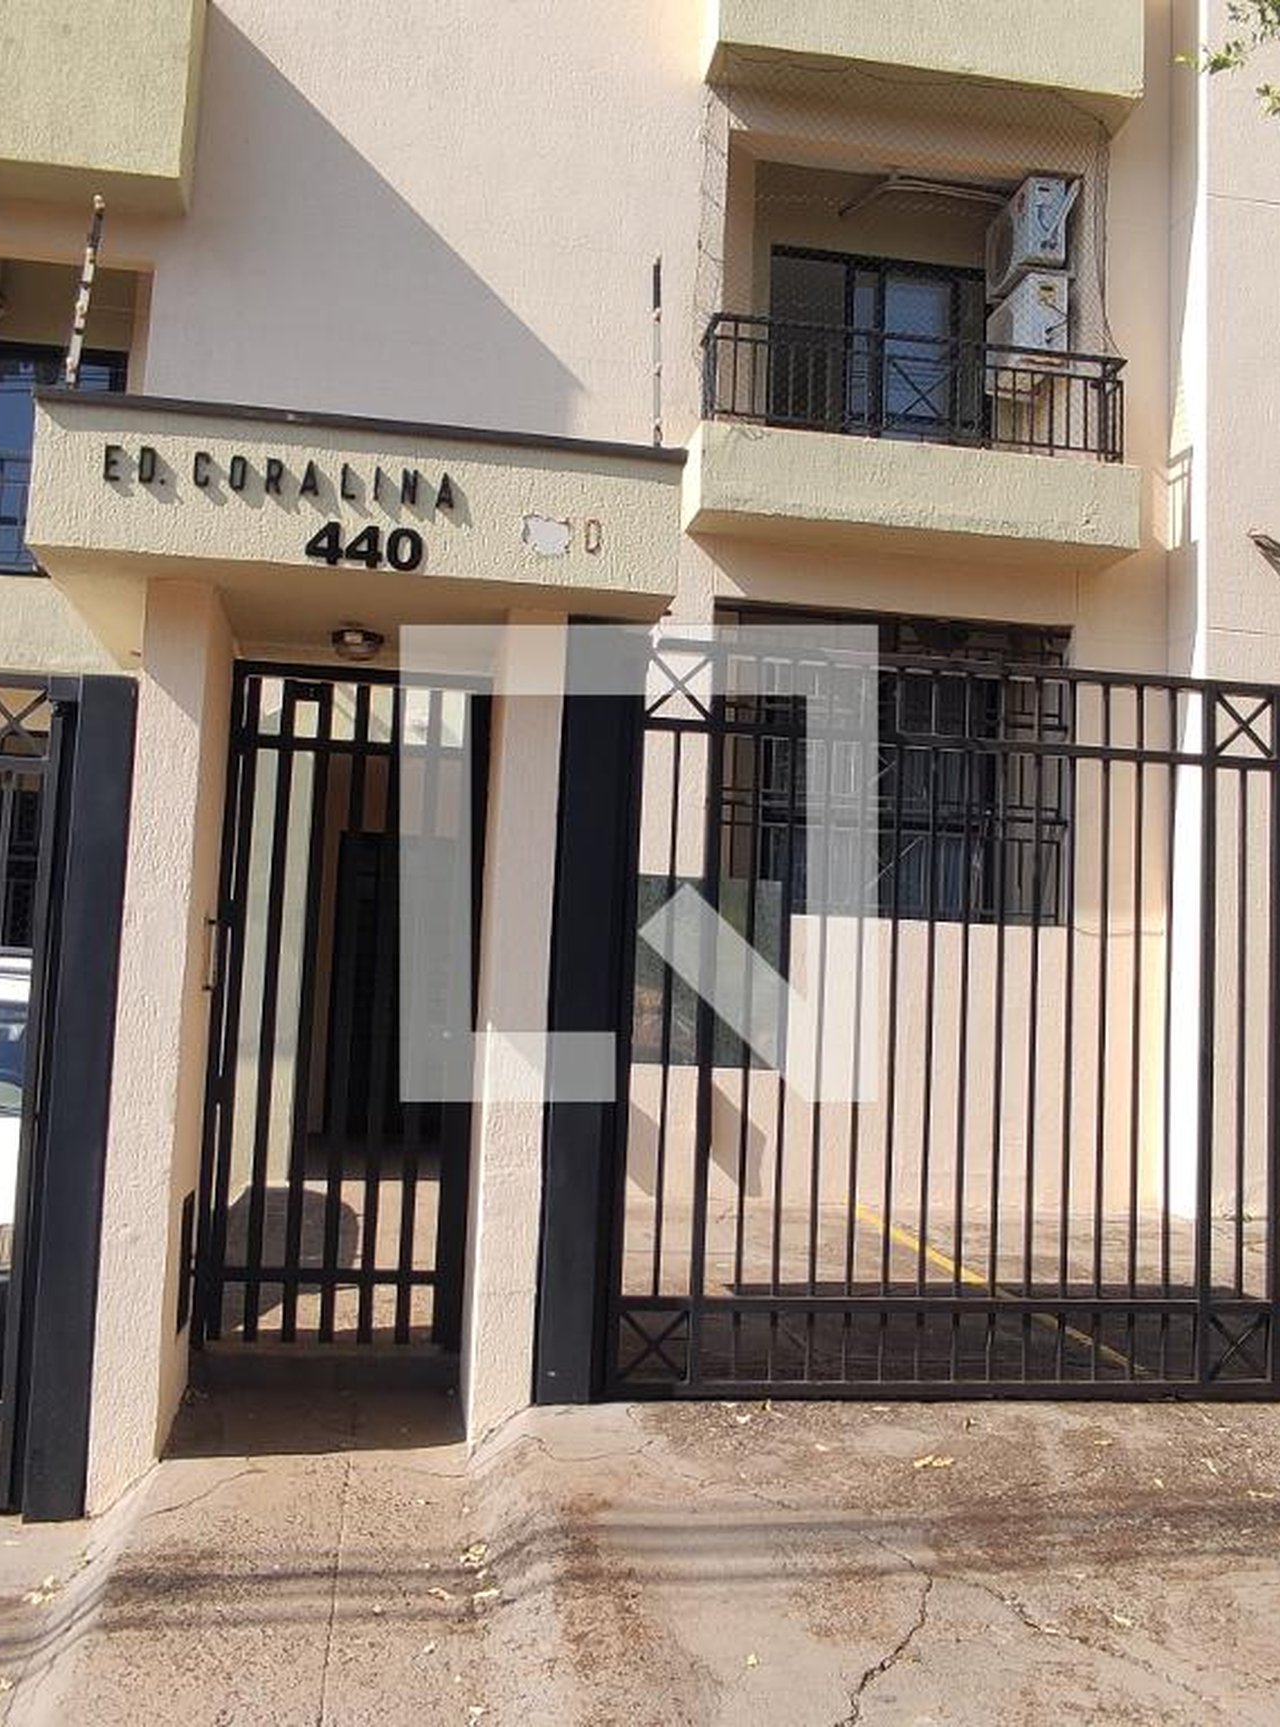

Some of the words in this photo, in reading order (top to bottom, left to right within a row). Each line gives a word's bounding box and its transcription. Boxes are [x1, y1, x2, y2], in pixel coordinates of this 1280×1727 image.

[103, 444, 166, 485] ED.
[193, 451, 454, 509] CORALINA
[304, 521, 424, 572] 440
